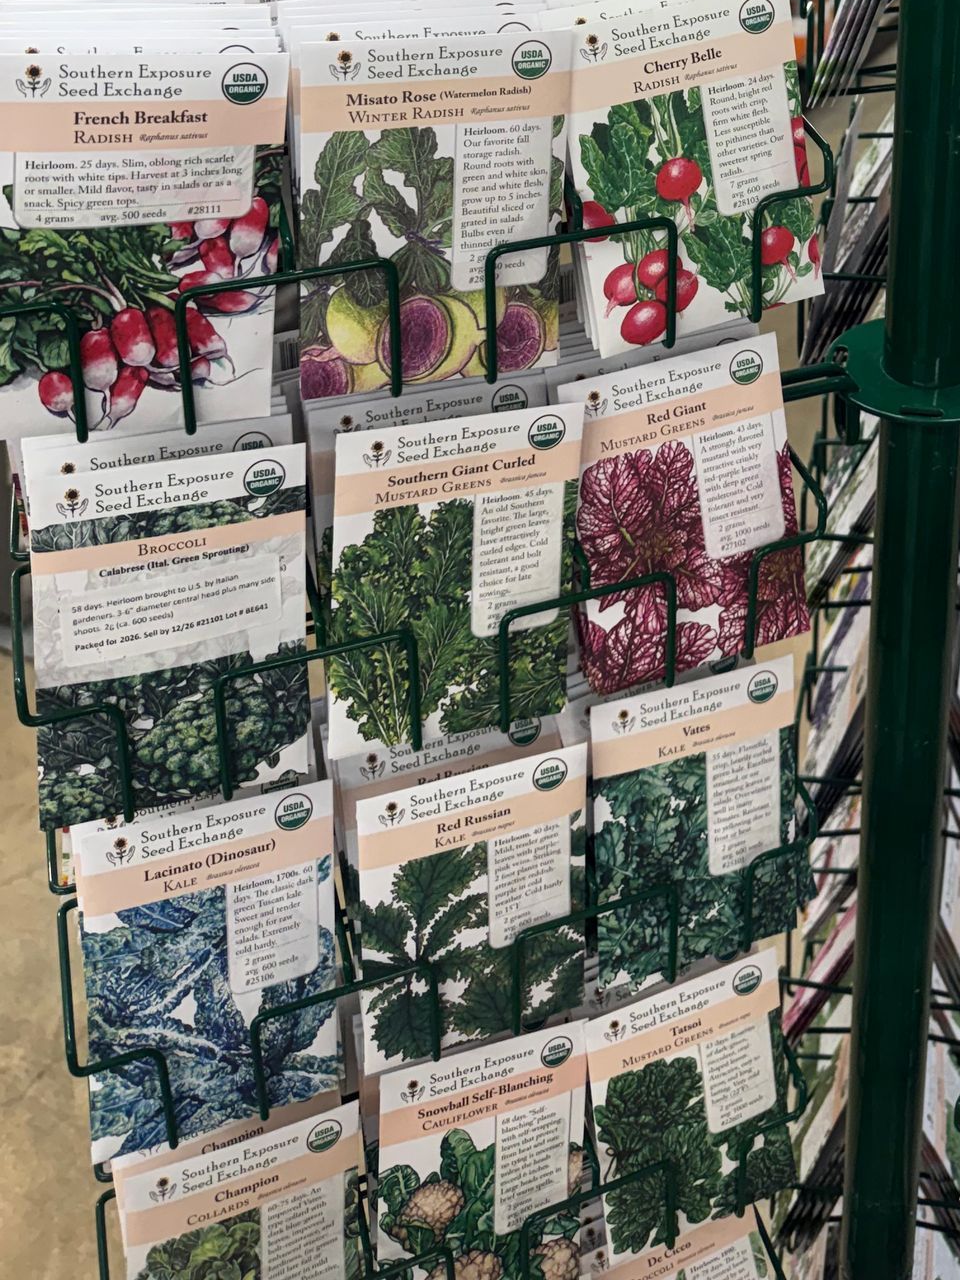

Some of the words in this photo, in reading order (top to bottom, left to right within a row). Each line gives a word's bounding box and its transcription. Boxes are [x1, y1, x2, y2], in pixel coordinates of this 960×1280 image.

[58, 64, 133, 79] Southern
[138, 65, 212, 80] Exposure
[643, 58, 688, 78] Cherry
[691, 48, 722, 64] Belle
[232, 73, 258, 83] USDA
[58, 83, 98, 97] Seed
[103, 81, 183, 99] Exchange
[228, 84, 261, 93] ORGANIC
[346, 94, 398, 107] Misato
[402, 91, 436, 104] Rose
[440, 89, 497, 100] (Watermelon
[499, 86, 532, 95] Radish)
[73, 111, 130, 125] French
[134, 110, 208, 125] Breakfast
[25, 160, 77, 170] Heirloom.
[80, 160, 92, 169] 25
[98, 158, 119, 170] days.
[122, 158, 147, 169] Slim,
[149, 157, 182, 169] oblong
[184, 155, 202, 166] rich
[205, 155, 234, 164] scarlet
[36, 215, 42, 223] 4
[45, 215, 74, 225] grams
[100, 213, 120, 222] avg.
[123, 210, 139, 219] 500
[142, 209, 167, 219] seeds
[187, 205, 221, 215] #28111
[646, 409, 670, 425] Red
[673, 401, 706, 417] Giant
[387, 470, 448, 488] Southern
[452, 463, 489, 478] Giant
[492, 454, 536, 470] Curled
[683, 723, 711, 737] Vates
[436, 820, 461, 834] Red
[465, 806, 511, 827] Russian
[144, 860, 202, 882] Lacinato
[206, 838, 276, 869] (Dinosaur)
[670, 1018, 702, 1037] Tatsoi
[417, 1096, 470, 1120] Snowball
[472, 1072, 553, 1105] Self-Blanching
[215, 1173, 279, 1203] Champion
